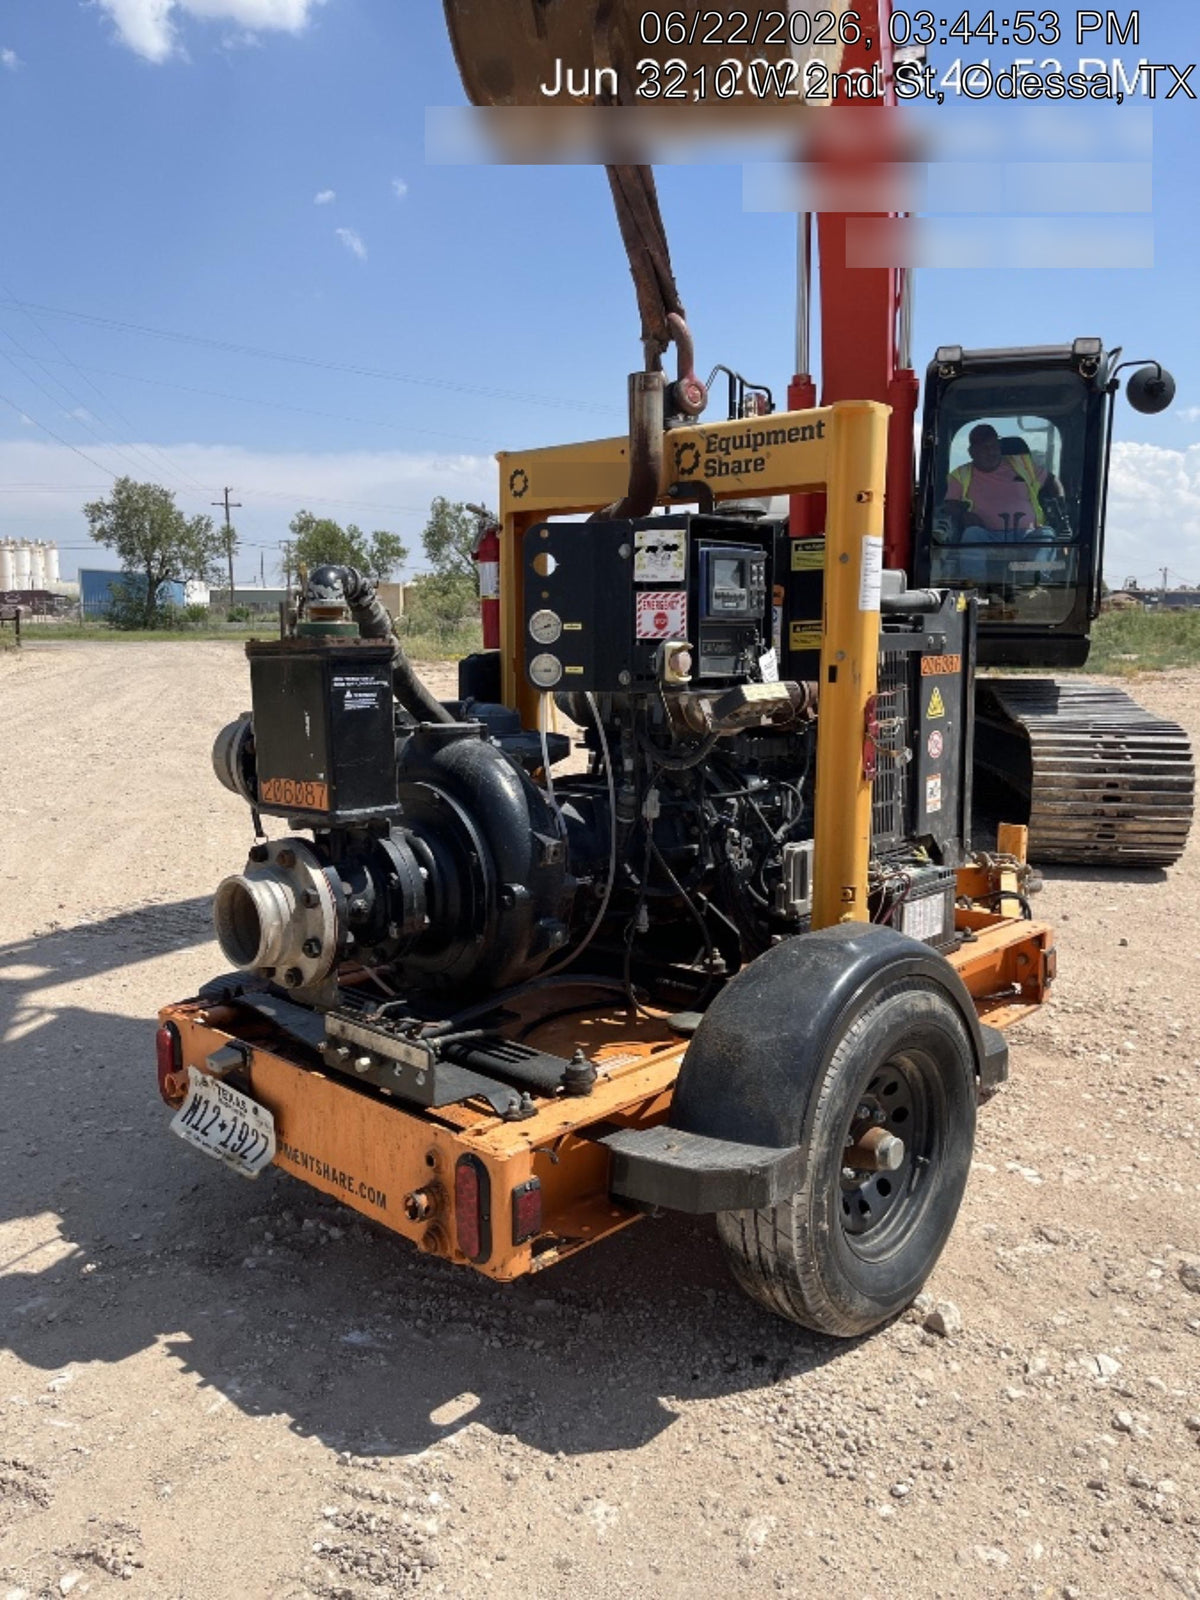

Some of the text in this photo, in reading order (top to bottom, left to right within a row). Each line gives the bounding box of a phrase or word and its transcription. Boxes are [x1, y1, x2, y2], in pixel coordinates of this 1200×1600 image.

[705, 419, 825, 455] Equipment
[704, 455, 765, 477] Share
[263, 779, 326, 807] 206087
[215, 1083, 247, 1113] TEXAS
